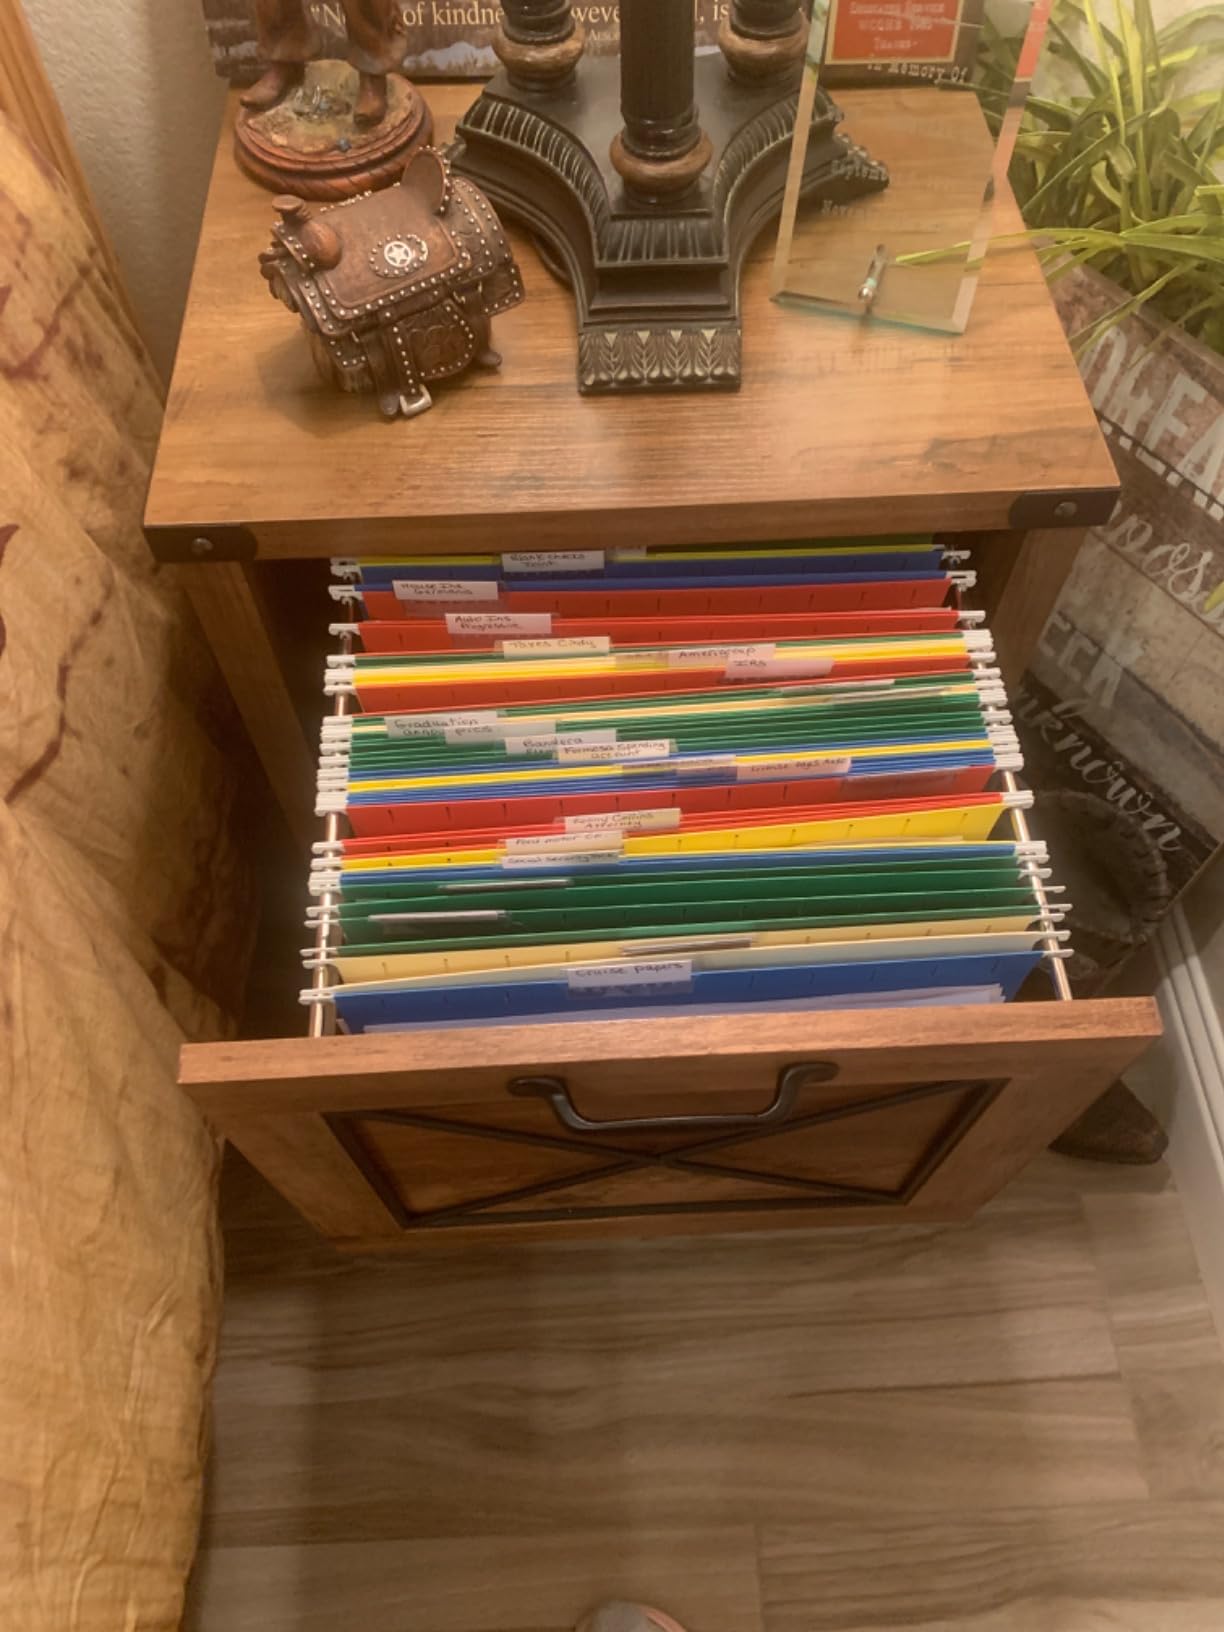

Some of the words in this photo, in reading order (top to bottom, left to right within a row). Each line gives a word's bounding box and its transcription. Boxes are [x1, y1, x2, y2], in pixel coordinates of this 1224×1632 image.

[402, 1, 425, 25] of
[432, 0, 505, 25] kindne
[713, 0, 730, 21] is
[887, 58, 946, 84] Memory
[951, 65, 968, 83] Of
[1078, 322, 1224, 522] DREA
[1014, 686, 1184, 852] nknown
